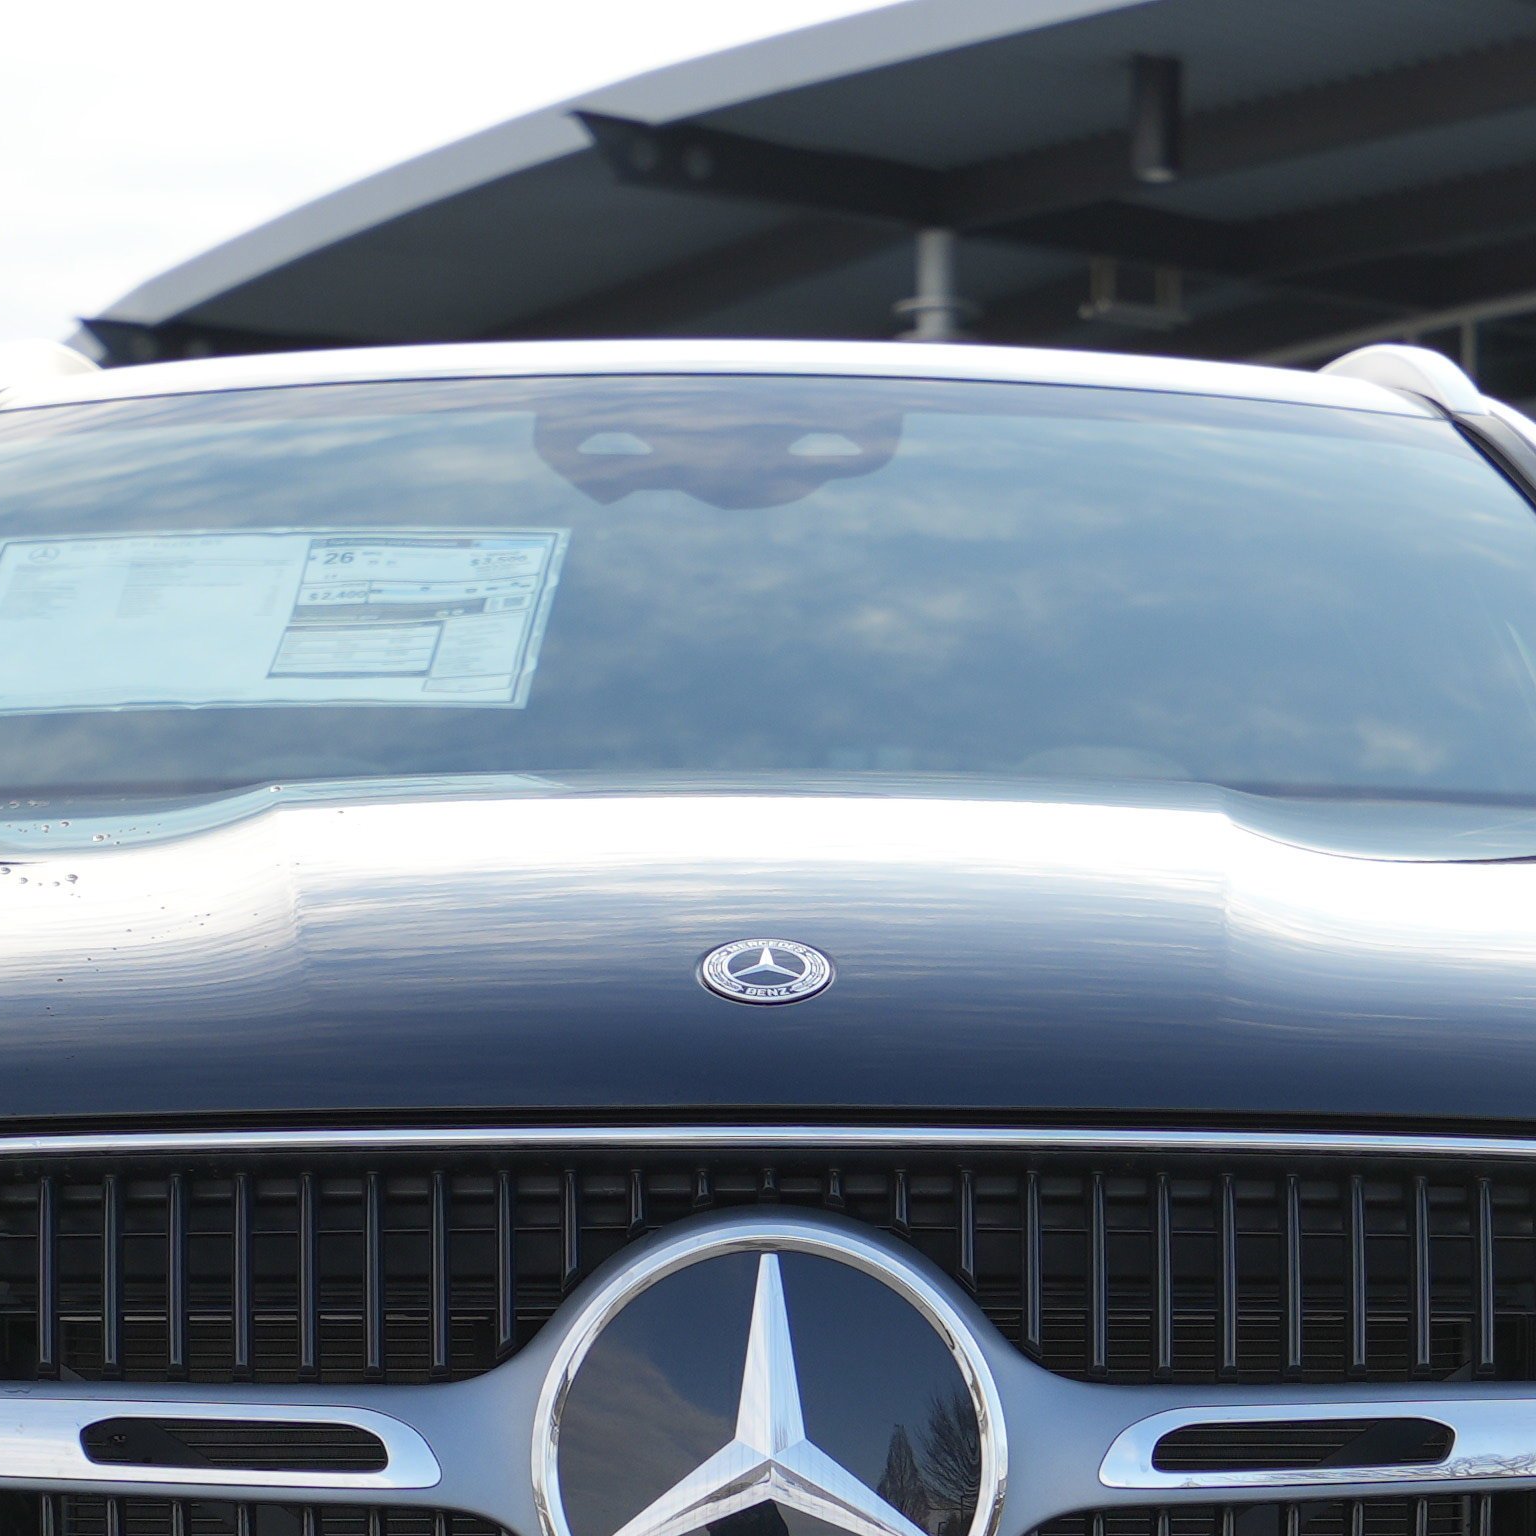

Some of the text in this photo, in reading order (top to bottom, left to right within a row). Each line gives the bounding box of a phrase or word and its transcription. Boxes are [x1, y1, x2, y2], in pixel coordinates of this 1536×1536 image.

[323, 552, 354, 566] 26
[726, 940, 807, 954] MERCEDES
[745, 987, 789, 997] BENZ
